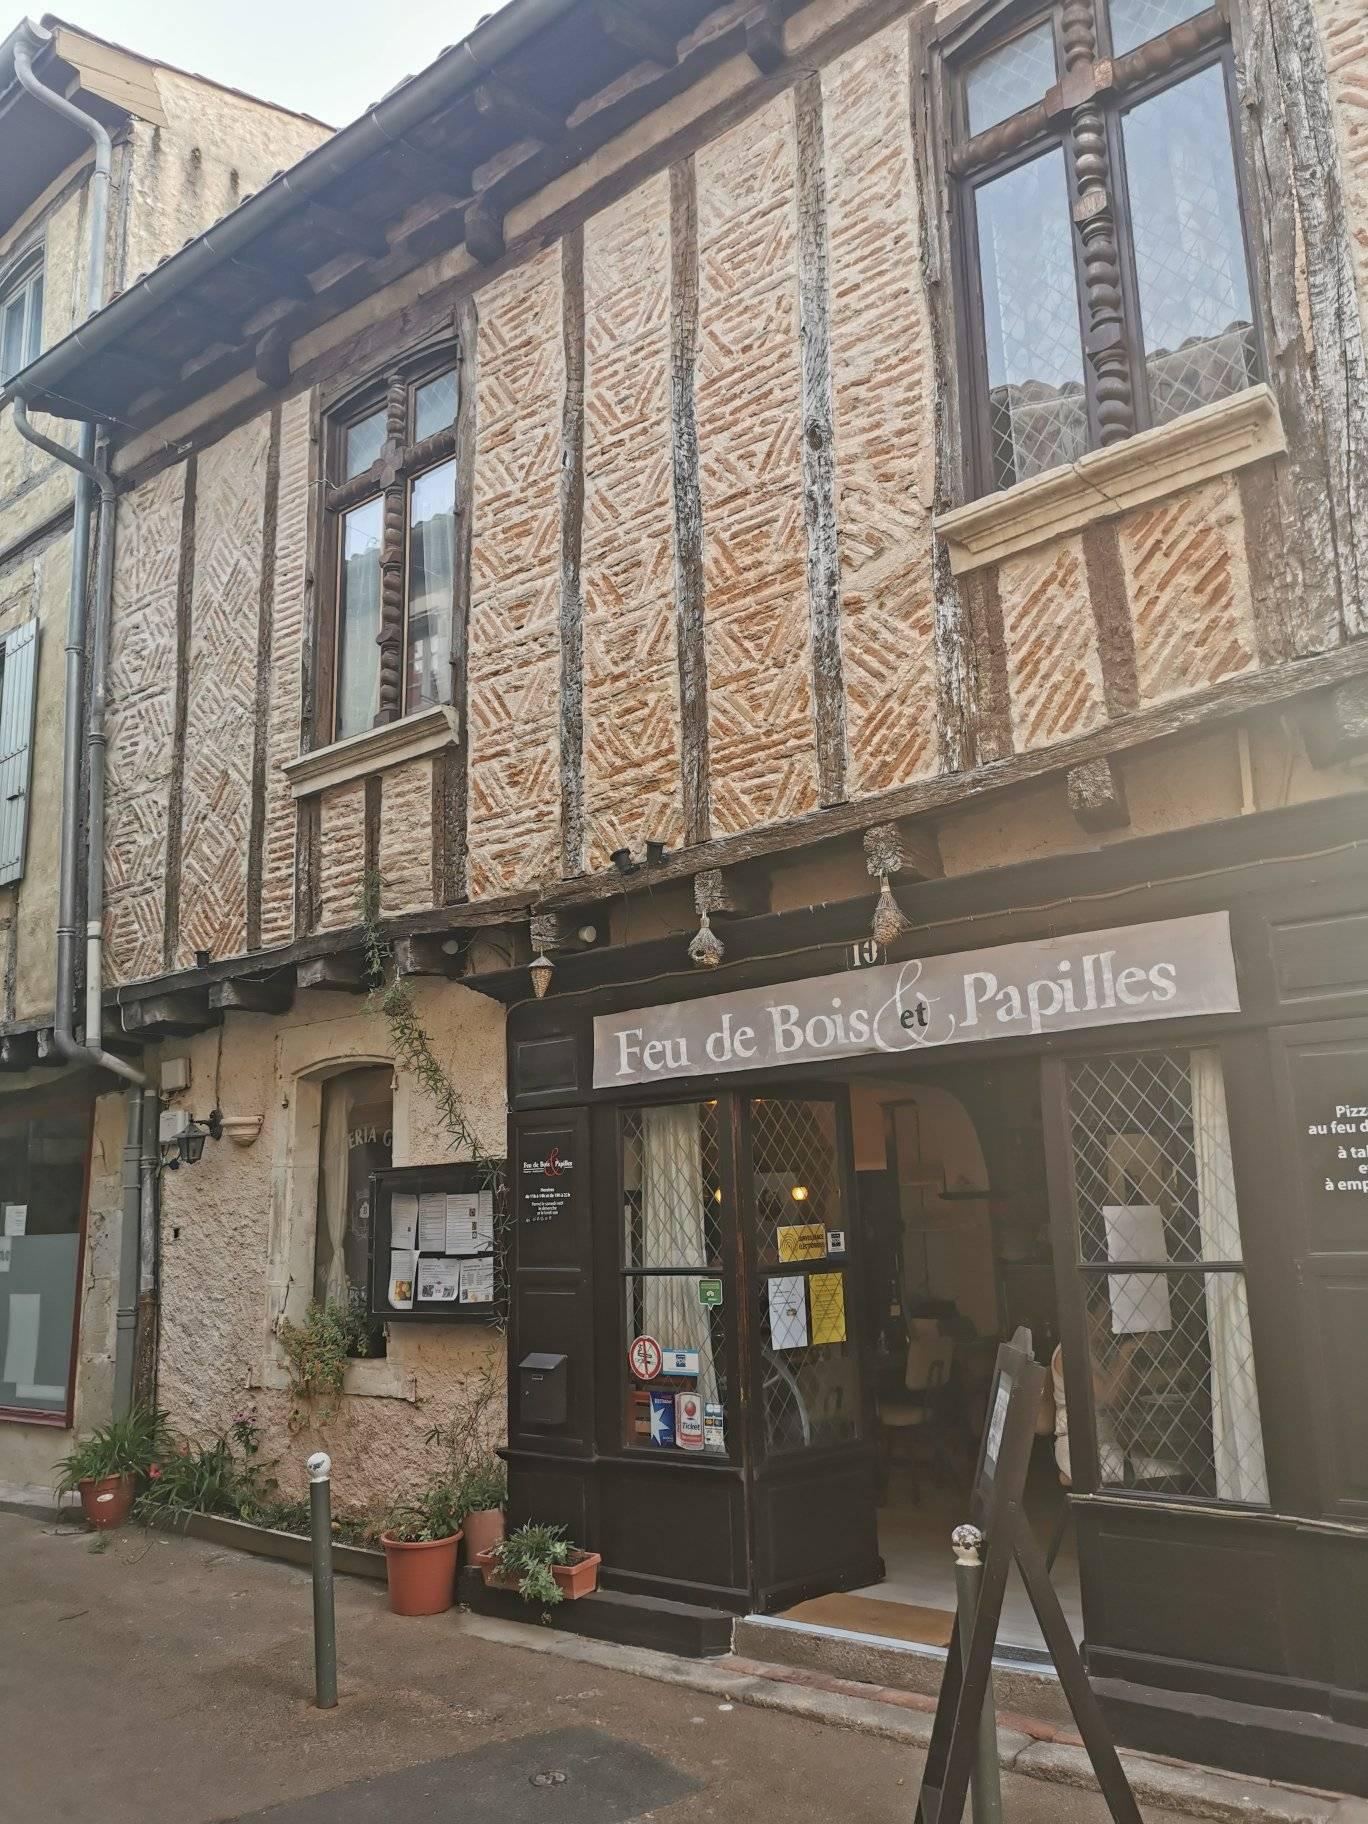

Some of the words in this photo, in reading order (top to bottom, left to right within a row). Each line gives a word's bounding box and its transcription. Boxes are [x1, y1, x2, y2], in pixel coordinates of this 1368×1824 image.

[614, 1028, 691, 1076] Feu
[705, 1014, 757, 1062] de
[766, 997, 870, 1053] Bois
[900, 1002, 928, 1029] et
[959, 950, 1177, 1035] Papilles
[1335, 1105, 1368, 1118] Pizz
[1308, 1124, 1327, 1135] au
[1330, 1121, 1356, 1134] feu
[1337, 1145, 1347, 1159] à
[1350, 1145, 1368, 1158] ta
[1358, 1164, 1368, 1174] e
[1325, 1177, 1335, 1191] à
[682, 1422, 700, 1432] Ticket
